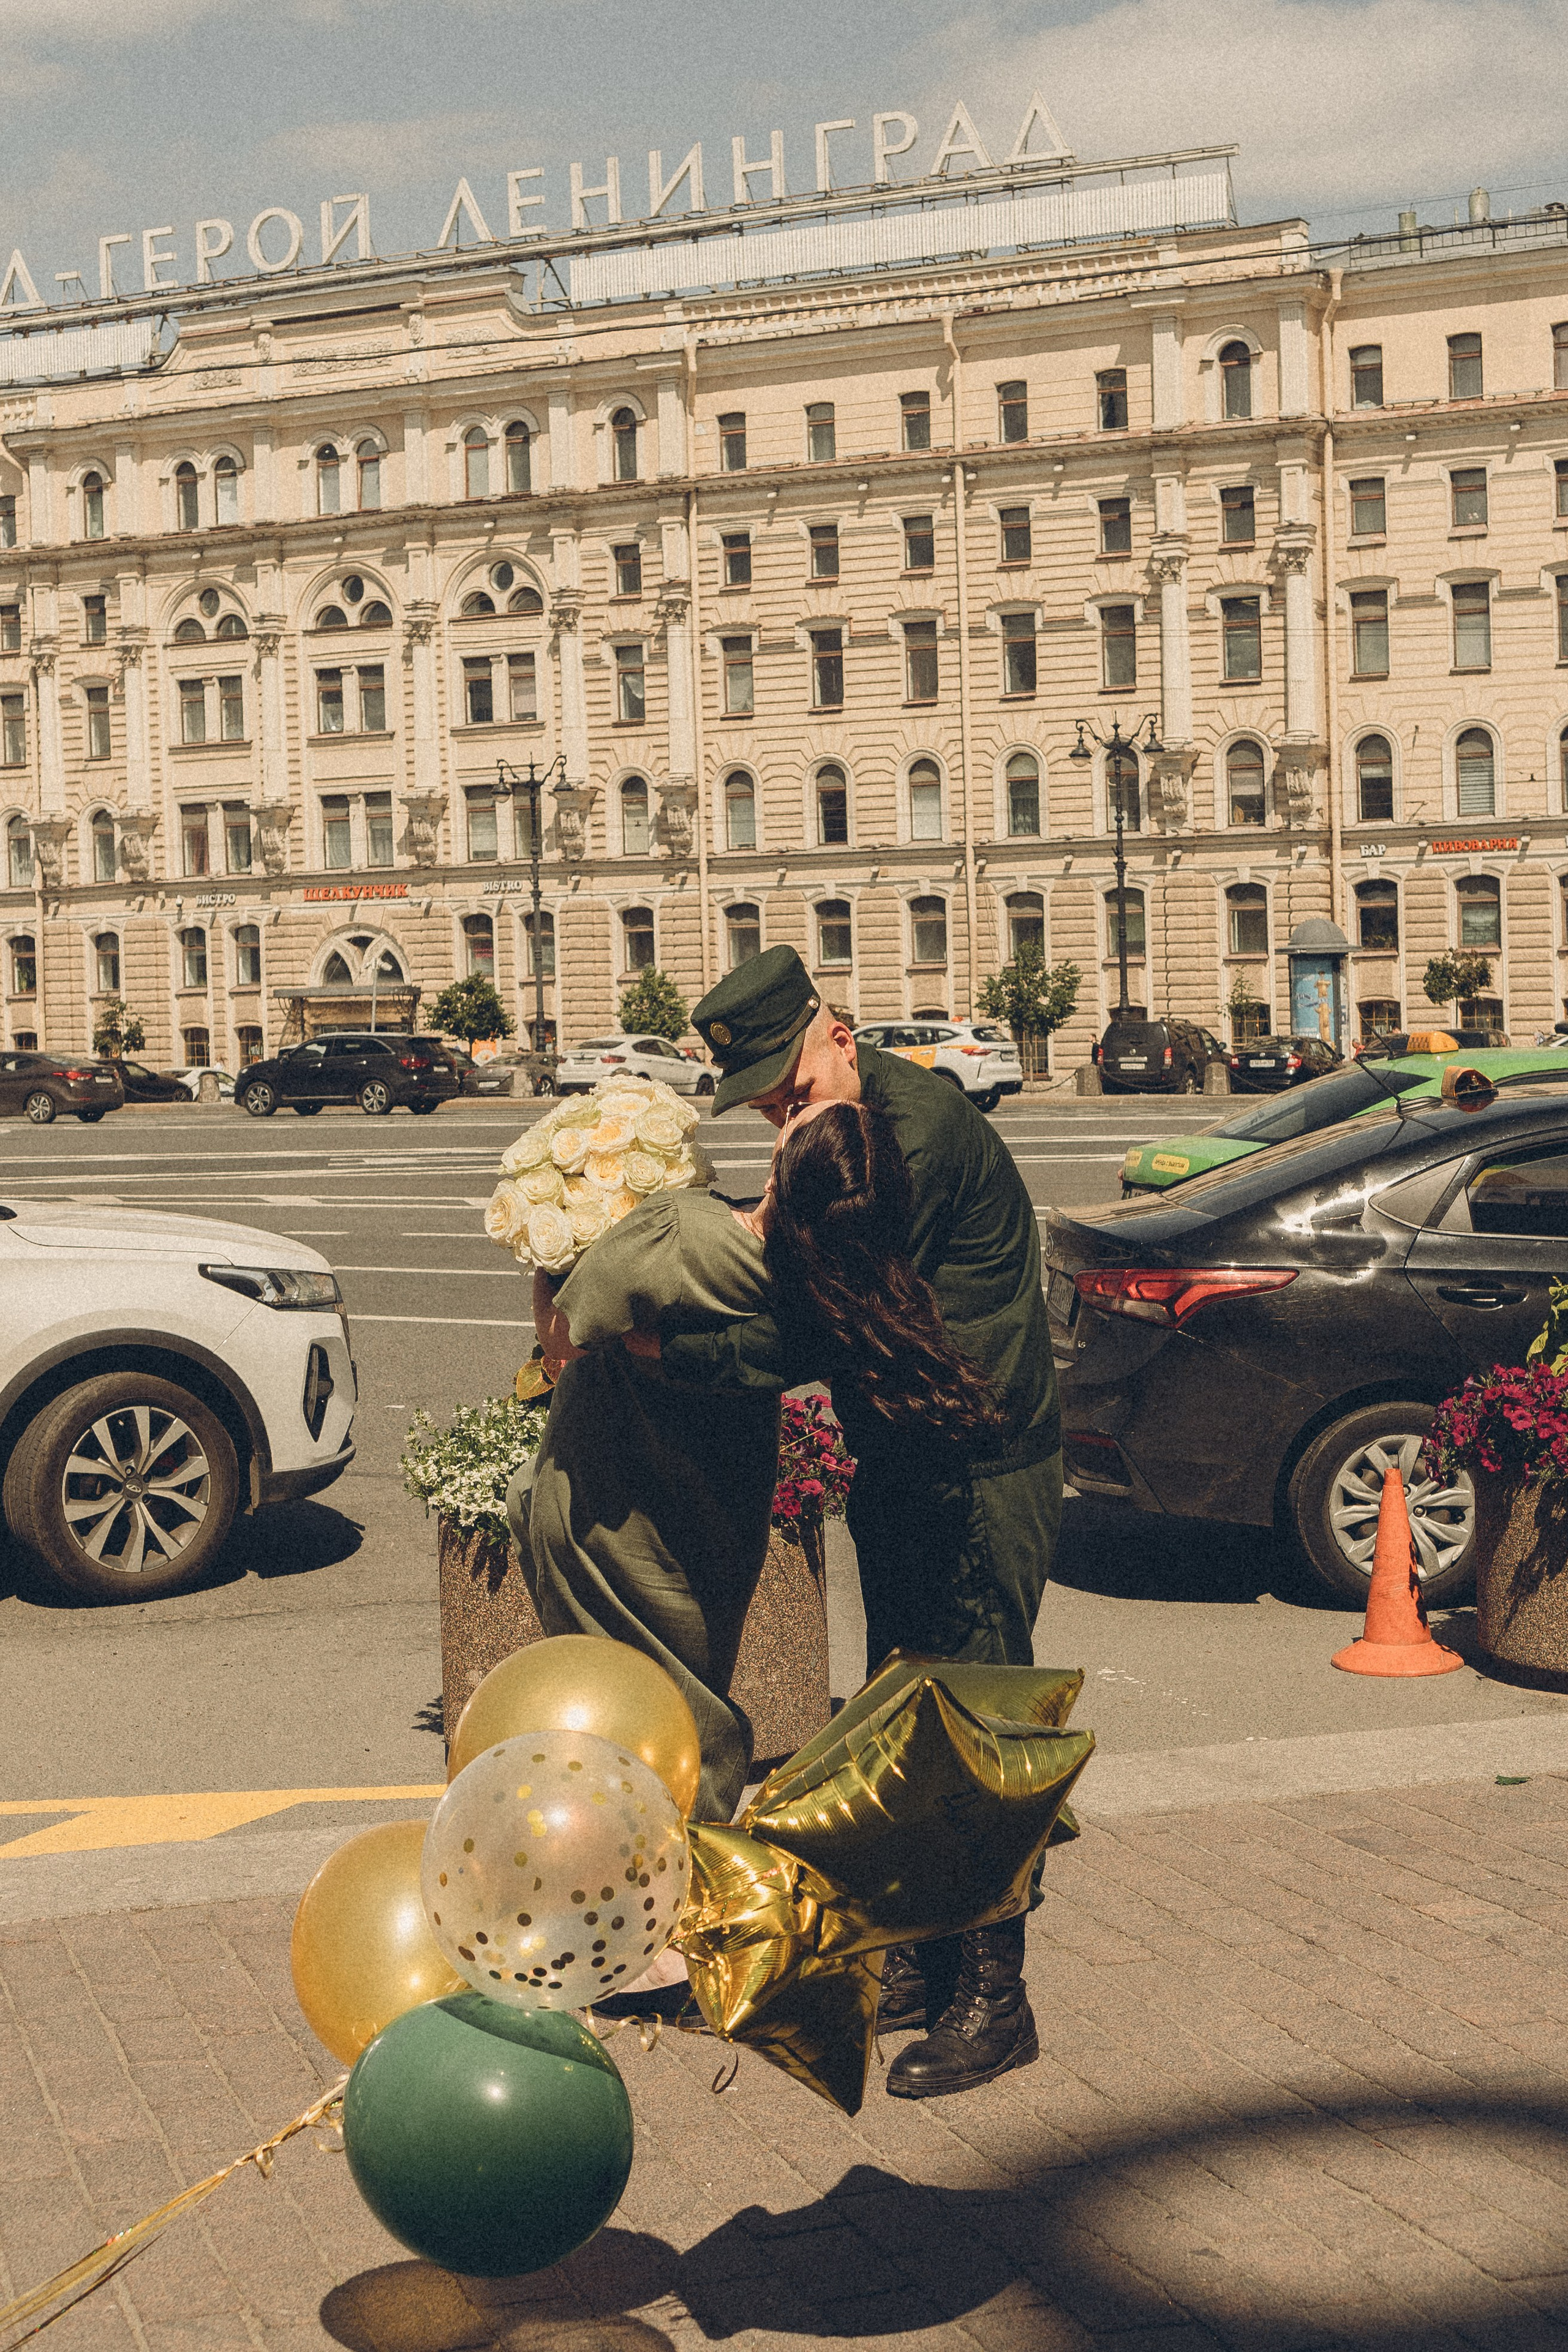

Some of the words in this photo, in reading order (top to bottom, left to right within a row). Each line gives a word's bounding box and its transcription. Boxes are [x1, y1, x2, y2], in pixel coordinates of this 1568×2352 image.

[437, 88, 1075, 247] ЛЕНИНГРАД
[1360, 845, 1387, 857] БАР
[1432, 838, 1518, 854] ПИВОВАРНЯ
[483, 880, 522, 892] BISTRO
[196, 894, 236, 905] БИСТРО
